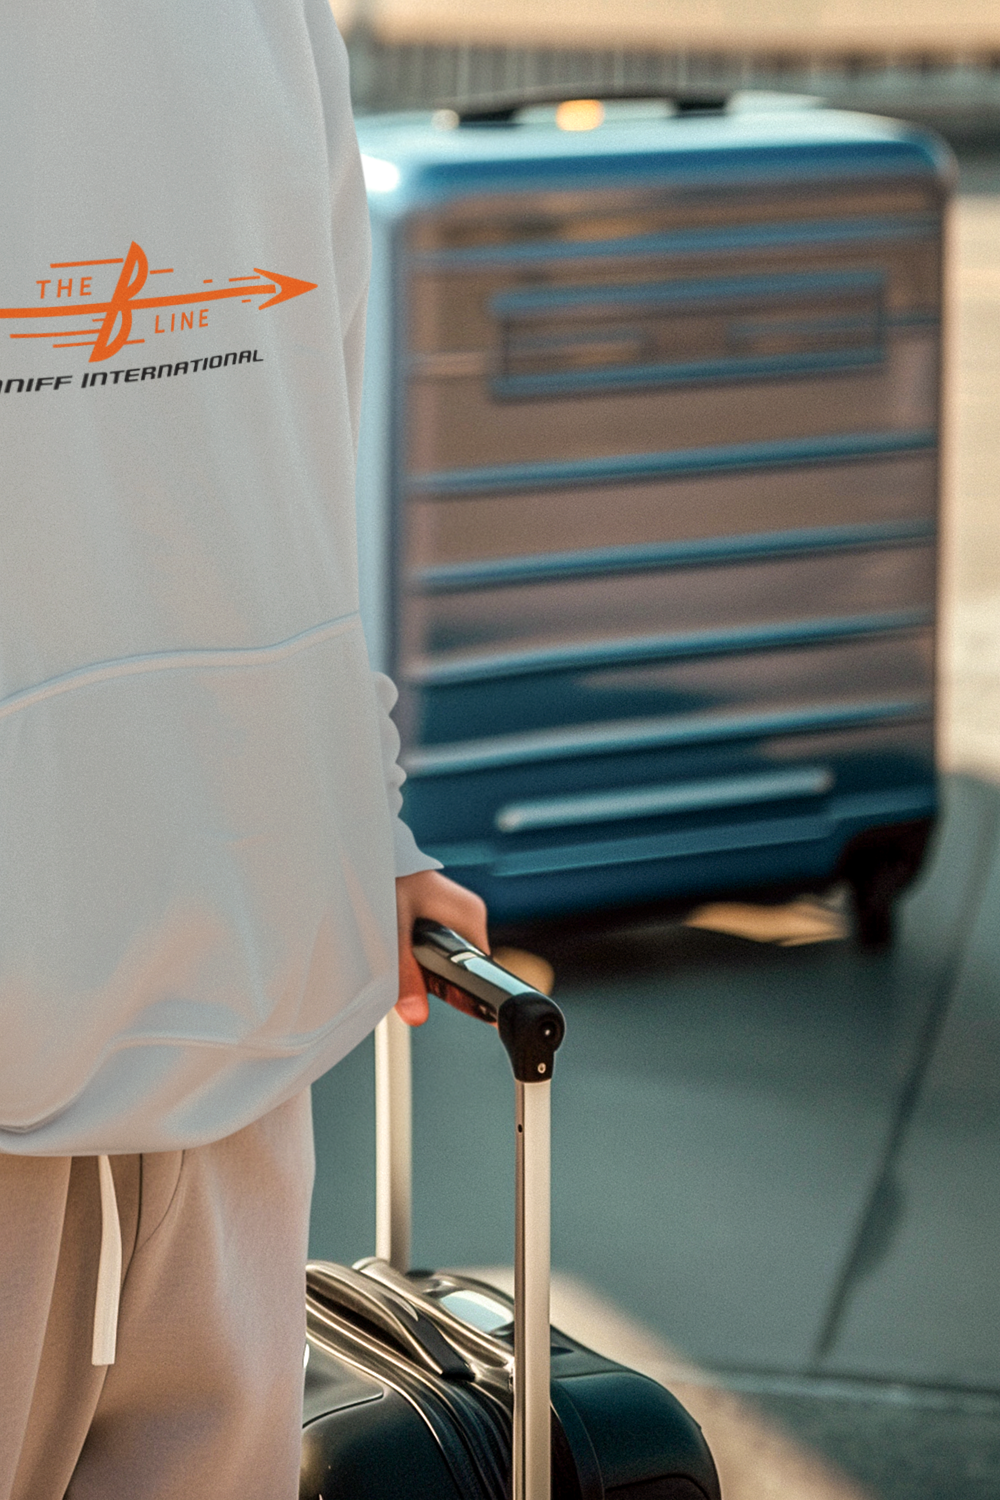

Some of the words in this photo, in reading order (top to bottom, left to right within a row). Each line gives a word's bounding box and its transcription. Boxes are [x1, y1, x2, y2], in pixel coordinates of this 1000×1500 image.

[36, 276, 93, 299] THE
[154, 309, 209, 333] LINE
[81, 350, 263, 388] INTERNATIONAL
